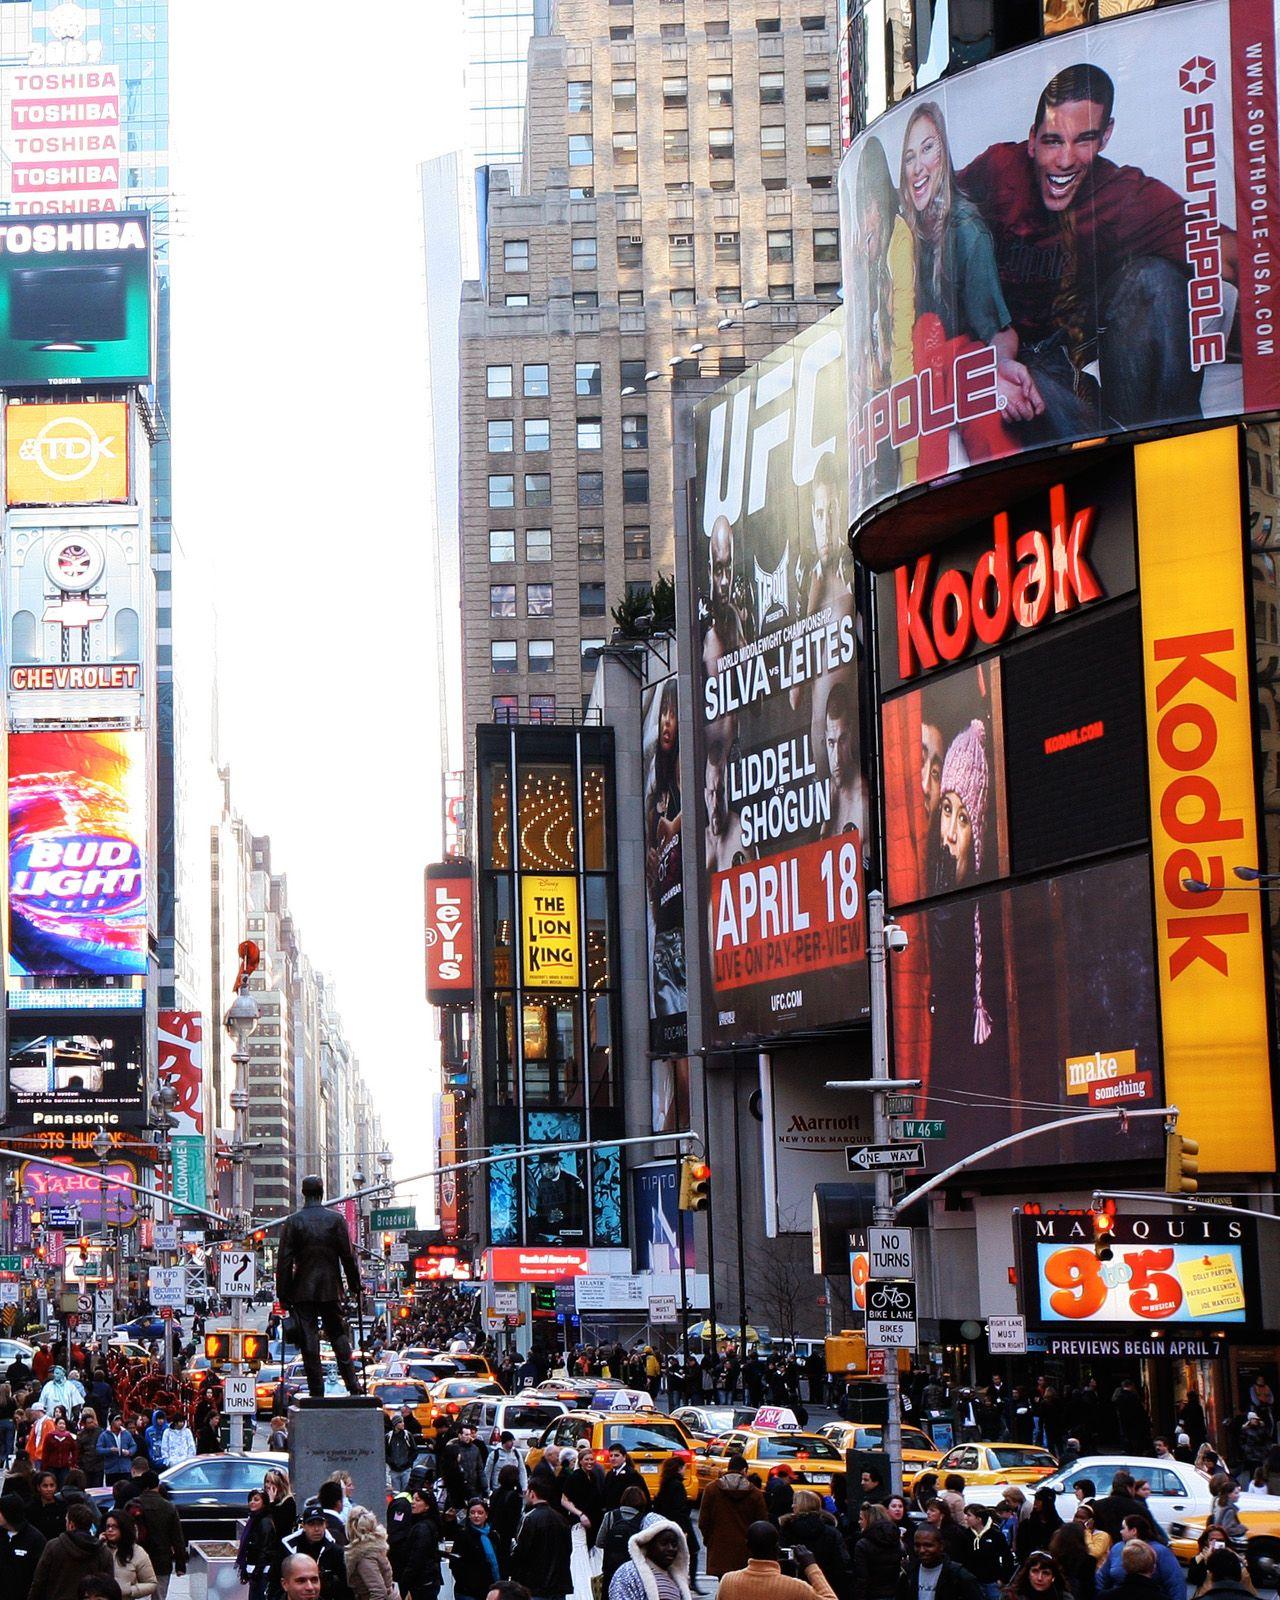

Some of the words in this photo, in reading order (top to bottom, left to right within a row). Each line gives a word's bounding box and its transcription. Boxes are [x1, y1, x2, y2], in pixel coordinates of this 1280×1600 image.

[14, 72, 116, 91] TOSHIBA
[13, 103, 117, 123] TOSHIBA
[14, 135, 117, 154] TOSHIBA
[13, 165, 118, 186] TOSHIBA
[14, 198, 116, 215] TOSHIBA
[1245, 42, 1274, 356] WWW.SOUTHPOLE-USA.COM
[1183, 102, 1226, 366] SOUTHPOLE
[703, 330, 842, 538] UFC
[44, 435, 118, 459] TDK
[894, 483, 1104, 680] Kodak
[716, 651, 739, 673] WORLD
[782, 607, 832, 642] CHAMPIONSHIP
[704, 653, 771, 721] SILVA
[779, 615, 854, 690] LEITES
[12, 666, 138, 690] CHEVROLET
[1044, 720, 1105, 755] KODAK.COM
[730, 734, 817, 802] LIDDELL
[740, 778, 831, 848] SHOGUN
[1153, 628, 1250, 982] Kodak
[27, 840, 133, 869] BUD
[12, 868, 143, 898] LIGHT
[534, 897, 565, 912] THE
[716, 857, 810, 951] APRIL
[820, 843, 859, 924] 18
[528, 916, 571, 942] LION
[529, 945, 573, 972] KING
[715, 952, 743, 984] LIVE
[744, 947, 764, 977] ON
[766, 918, 862, 970] PAY-PER-VIEW
[770, 990, 803, 1012] UFC.COM
[1068, 1051, 1118, 1086] make
[1094, 1079, 1146, 1101] something
[32, 1112, 119, 1125] Panasonic
[787, 1114, 861, 1133] Marriott
[906, 1122, 915, 1137] W
[918, 1122, 931, 1137] 46
[934, 1122, 942, 1131] ST
[858, 1152, 881, 1163] ONE
[890, 1151, 913, 1161] WAY
[27, 1171, 130, 1194] YAHOO!
[376, 1213, 411, 1227] Broadway
[1036, 1220, 1242, 1238] MAQUIS
[881, 1235, 900, 1249] NO
[223, 1254, 240, 1265] NO
[872, 1252, 910, 1268] TURNS
[1044, 1246, 1109, 1320] 9
[1097, 1260, 1133, 1289] to
[1123, 1247, 1183, 1320] 5
[1192, 1271, 1210, 1282] DOLLY
[1210, 1267, 1233, 1278] PARTON
[152, 1286, 182, 1294] SECURITY
[224, 1282, 251, 1292] TURN
[1186, 1286, 1212, 1297] PATRICIA
[869, 1310, 888, 1319] BIKE
[890, 1310, 914, 1320] LANE
[1149, 1301, 1176, 1312] MUSICAL
[879, 1324, 904, 1333] BIKES
[990, 1320, 1007, 1328] RIGHT
[880, 1334, 903, 1343] ONLY
[997, 1330, 1017, 1339] MUST
[1052, 1341, 1121, 1355] PREVIEWS
[1125, 1341, 1165, 1355] BEGIN
[1170, 1341, 1208, 1355] APRIL
[1212, 1341, 1220, 1355] 7
[233, 1383, 248, 1394] NO
[226, 1397, 255, 1408] TURNS
